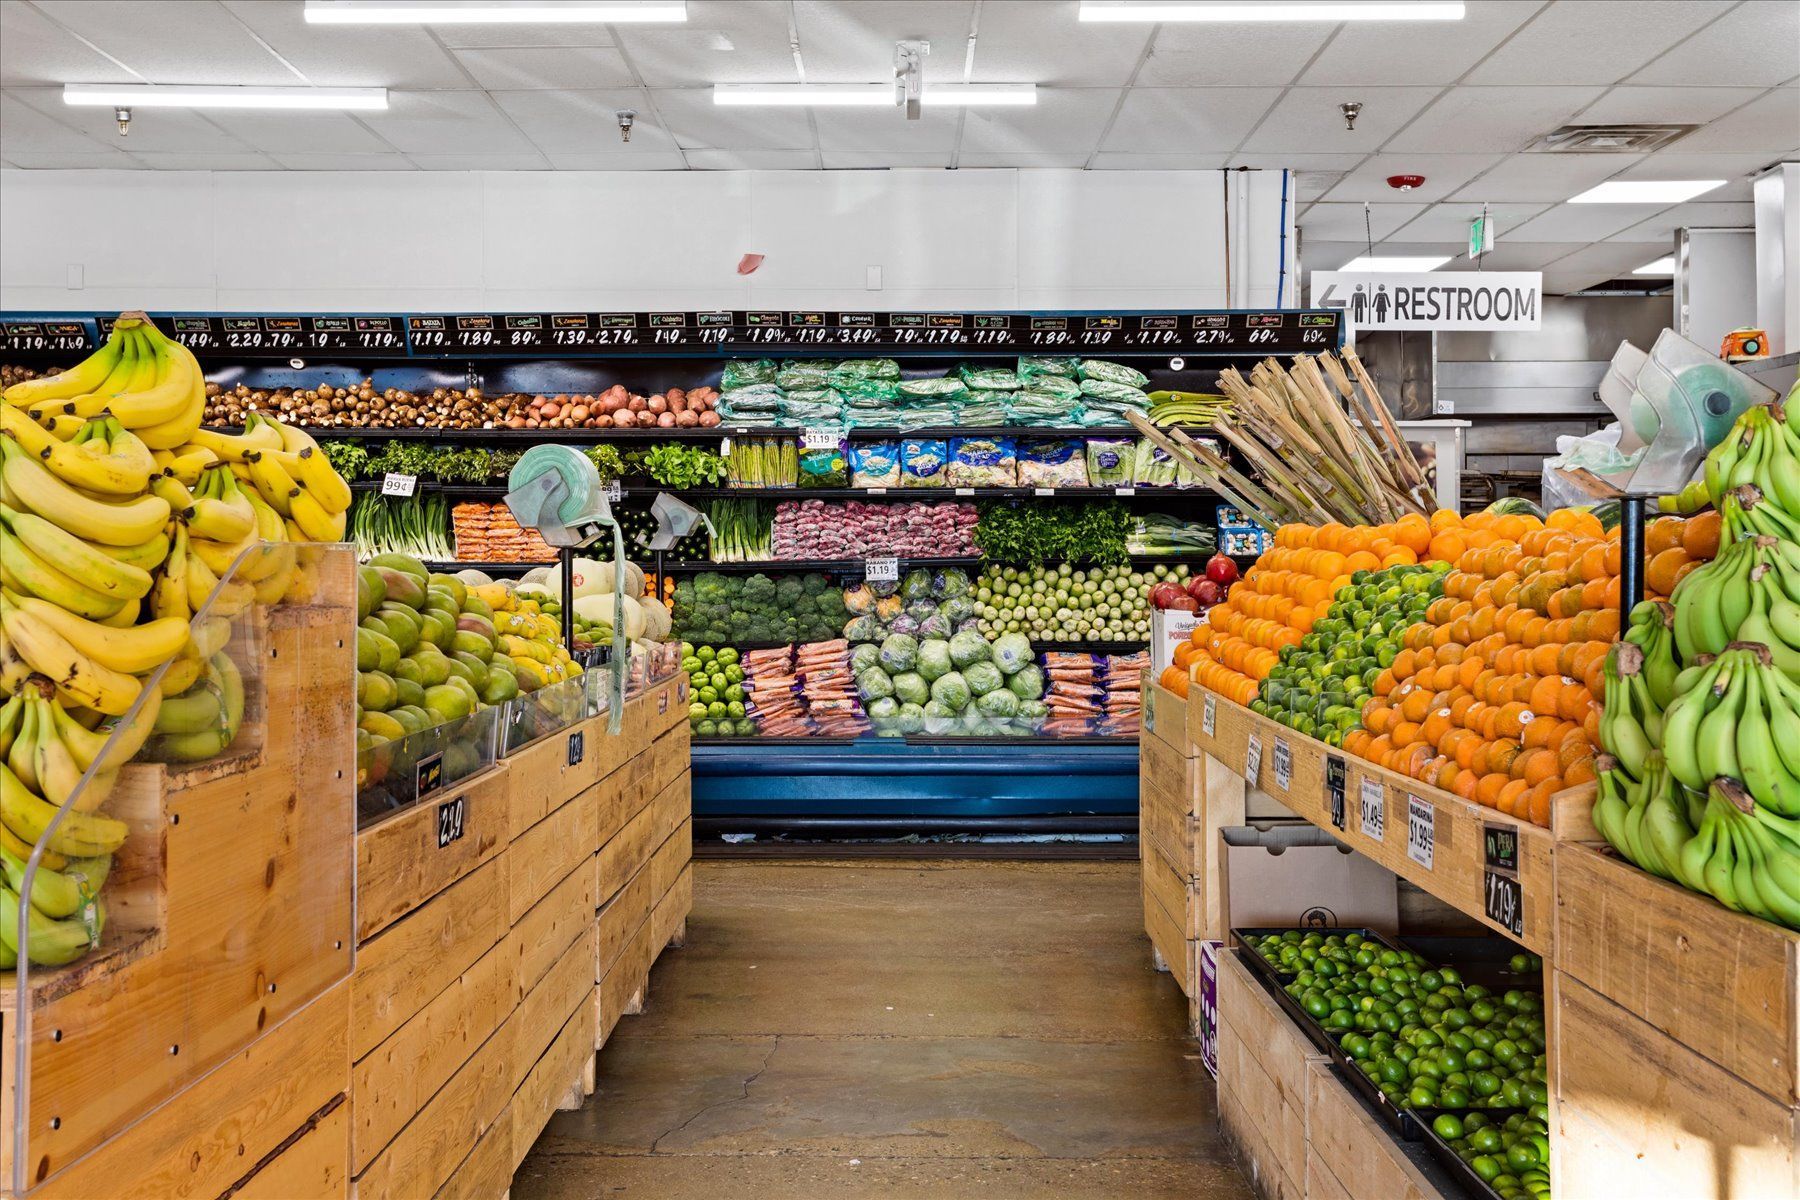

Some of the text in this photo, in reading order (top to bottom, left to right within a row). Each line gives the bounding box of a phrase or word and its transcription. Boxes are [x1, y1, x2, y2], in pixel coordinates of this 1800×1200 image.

[1394, 286, 1536, 322] RESTROOM
[807, 434, 830, 444] $1.19
[385, 480, 408, 492] 99¢
[867, 565, 890, 575] $1.19
[1410, 817, 1428, 851] $1.99
[1497, 832, 1515, 853] PERA
